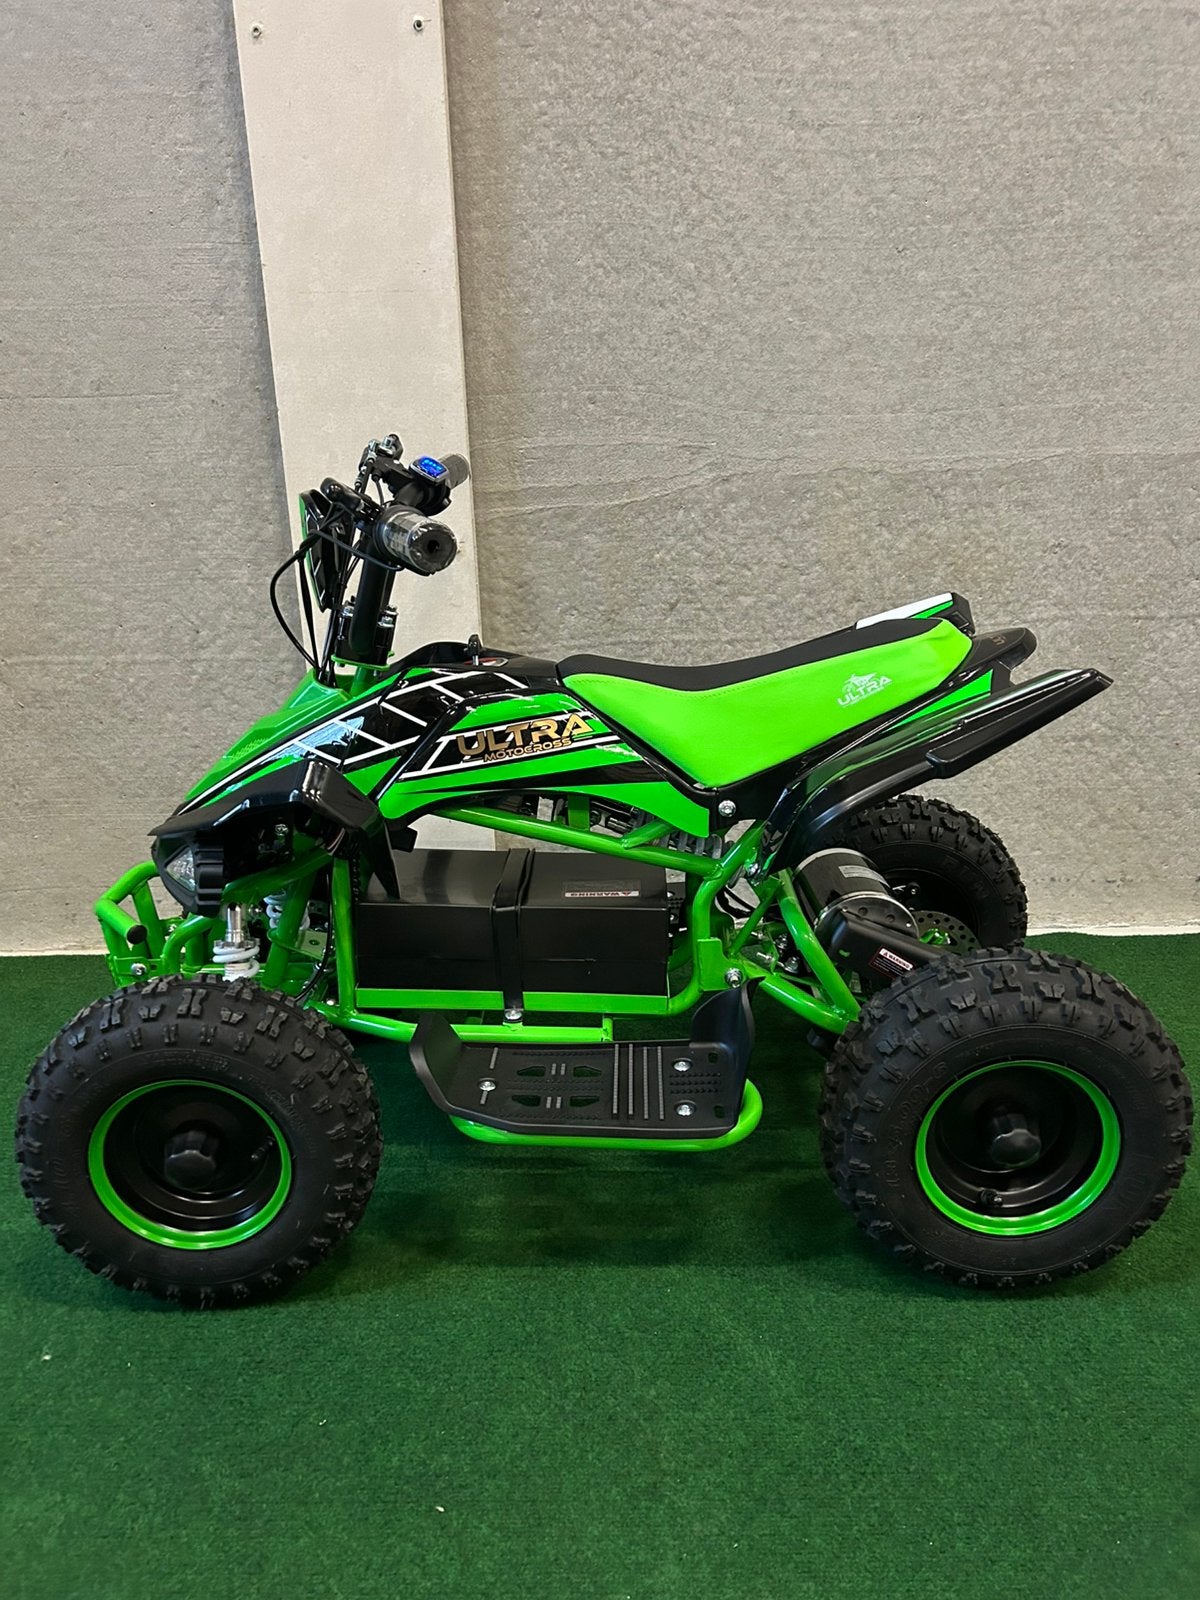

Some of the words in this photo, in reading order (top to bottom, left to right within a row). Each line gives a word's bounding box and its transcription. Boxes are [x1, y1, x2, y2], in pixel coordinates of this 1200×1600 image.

[837, 675, 893, 706] ULTRA
[456, 713, 594, 756] ULTRA
[483, 738, 573, 763] MOTOCROSS
[888, 953, 911, 970] WARNING
